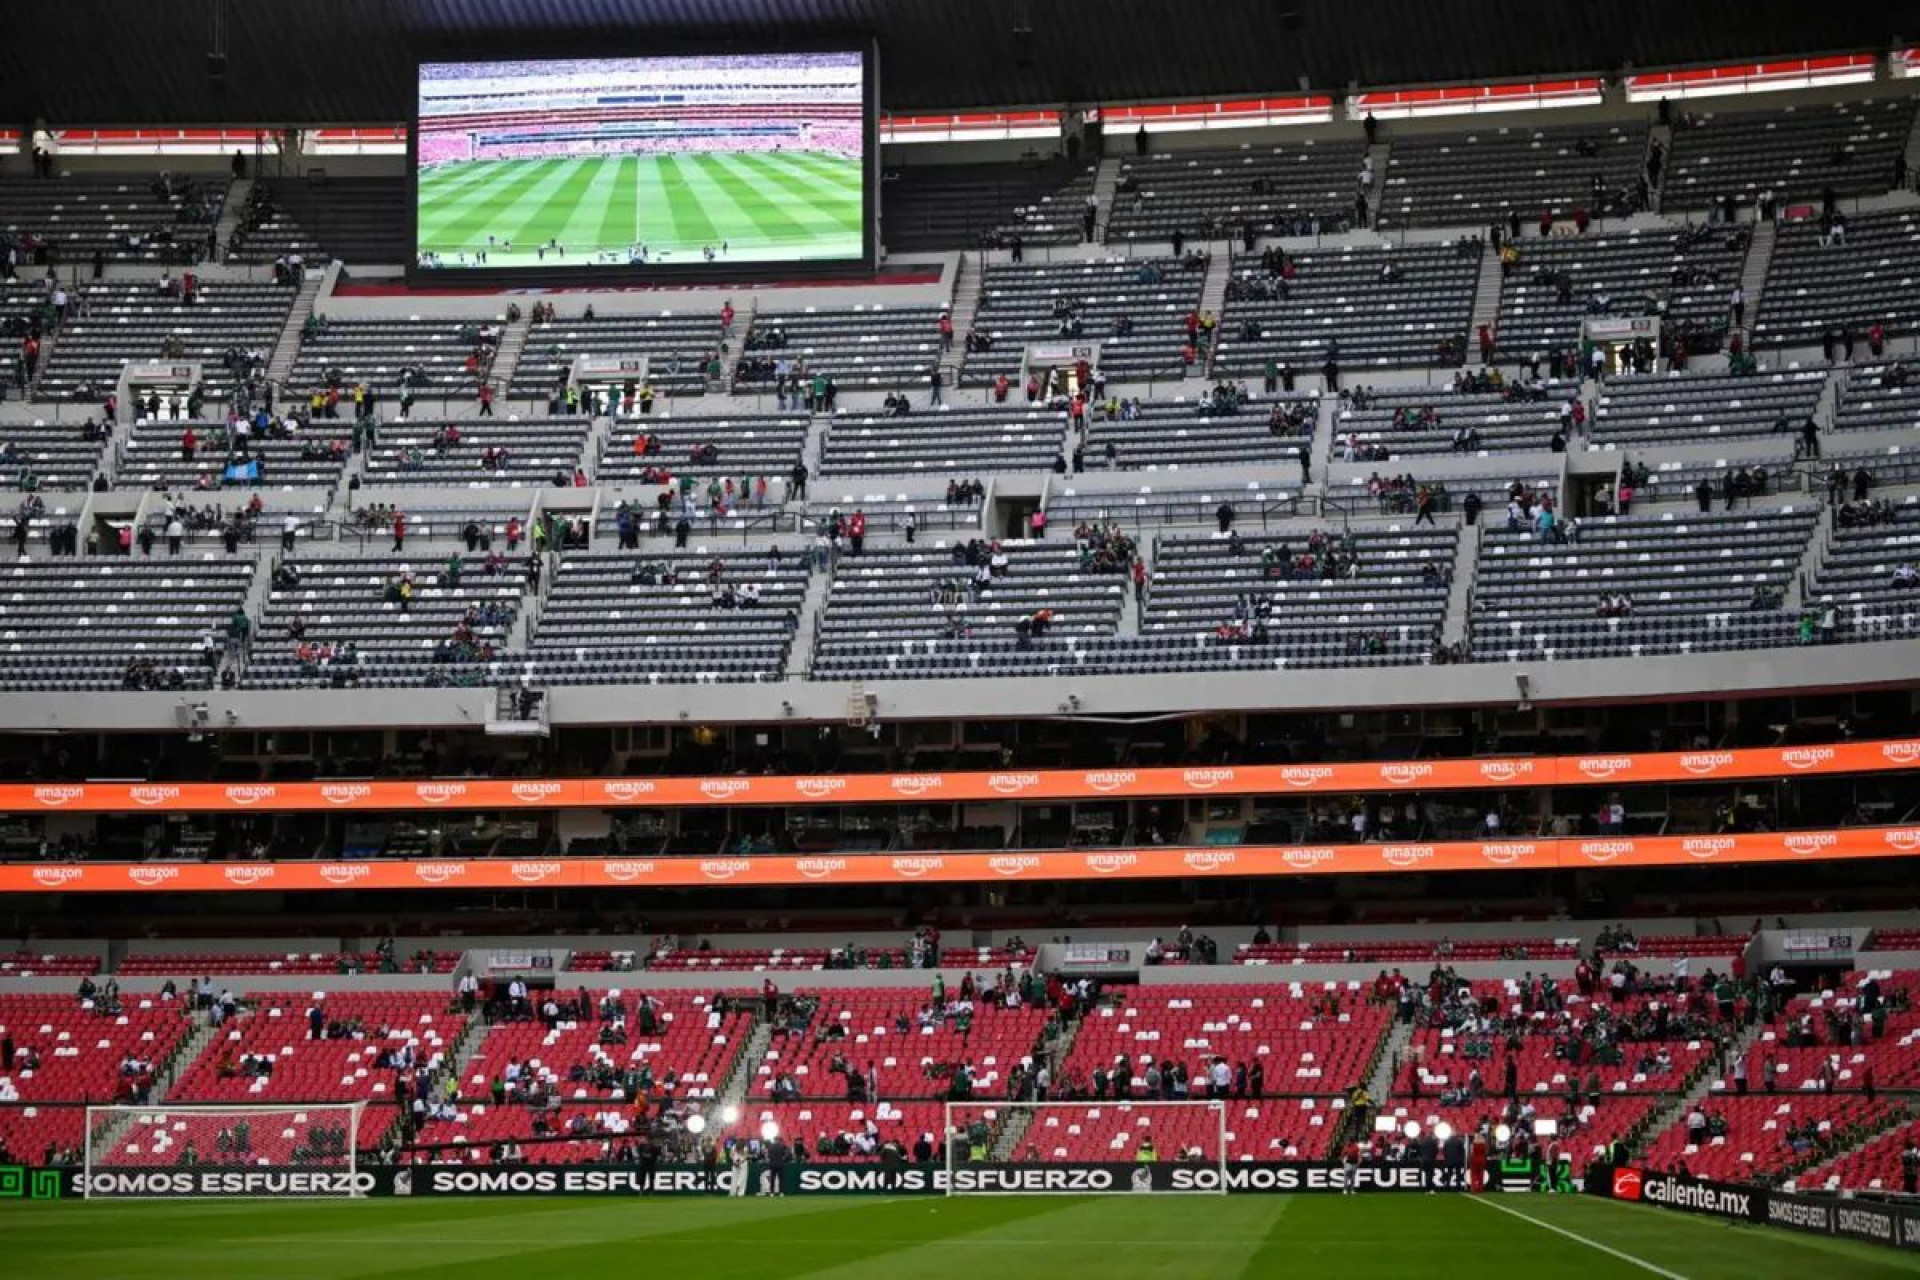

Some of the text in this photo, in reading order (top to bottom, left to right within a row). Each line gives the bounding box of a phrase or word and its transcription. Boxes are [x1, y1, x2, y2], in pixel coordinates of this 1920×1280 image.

[36, 743, 1920, 800] amazon amazon amazon amazon amazon amazon amazon amazon amazon amazon amazon amazon amazon amazon amazon amazon amazon amazon amazon amaz
[34, 830, 1920, 881] amazon amazon amazon amazon amazon amazon amazon amazon amazon amazon amazon amazon amazon amazon amazon amazon amazon amazon amazon amaz
[72, 1172, 375, 1193] SOMOS ESFUERZO
[432, 1171, 557, 1191] SOMOS
[933, 1170, 1113, 1190] ESFUERZO
[1171, 1168, 1298, 1188] SOMOS
[1644, 1176, 1750, 1215] caliente.mx
